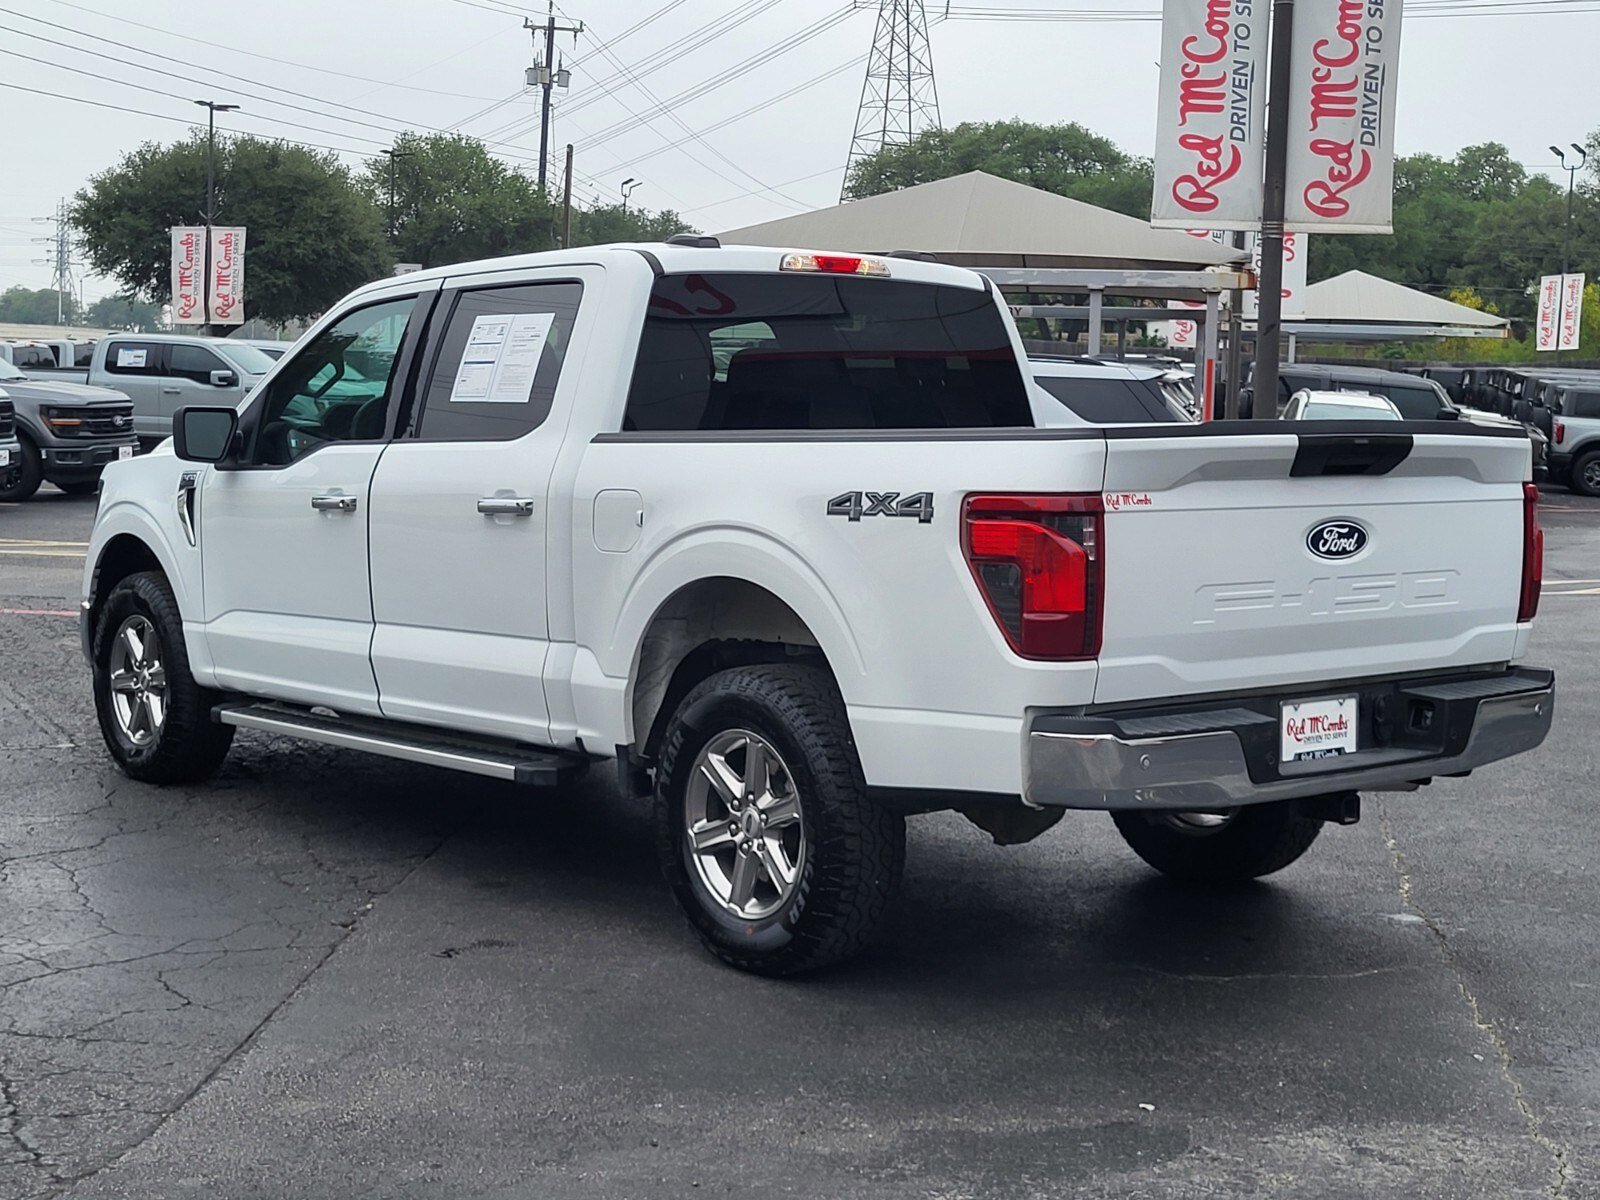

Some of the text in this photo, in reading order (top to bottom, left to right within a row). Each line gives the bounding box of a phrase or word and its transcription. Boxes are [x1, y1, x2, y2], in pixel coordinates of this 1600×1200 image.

[1233, 23, 1251, 53] TO
[1365, 26, 1383, 56] TO
[1230, 59, 1250, 142] DRIVEN
[1360, 62, 1380, 147] DRIVEN
[1172, 134, 1241, 213] Red
[1303, 138, 1371, 218] Red
[178, 233, 197, 319] Red McCombs
[215, 233, 235, 319] Red McCombs
[1106, 494, 1120, 510] Red
[1318, 526, 1359, 552] Ford
[1287, 713, 1349, 742] Red McCombs
